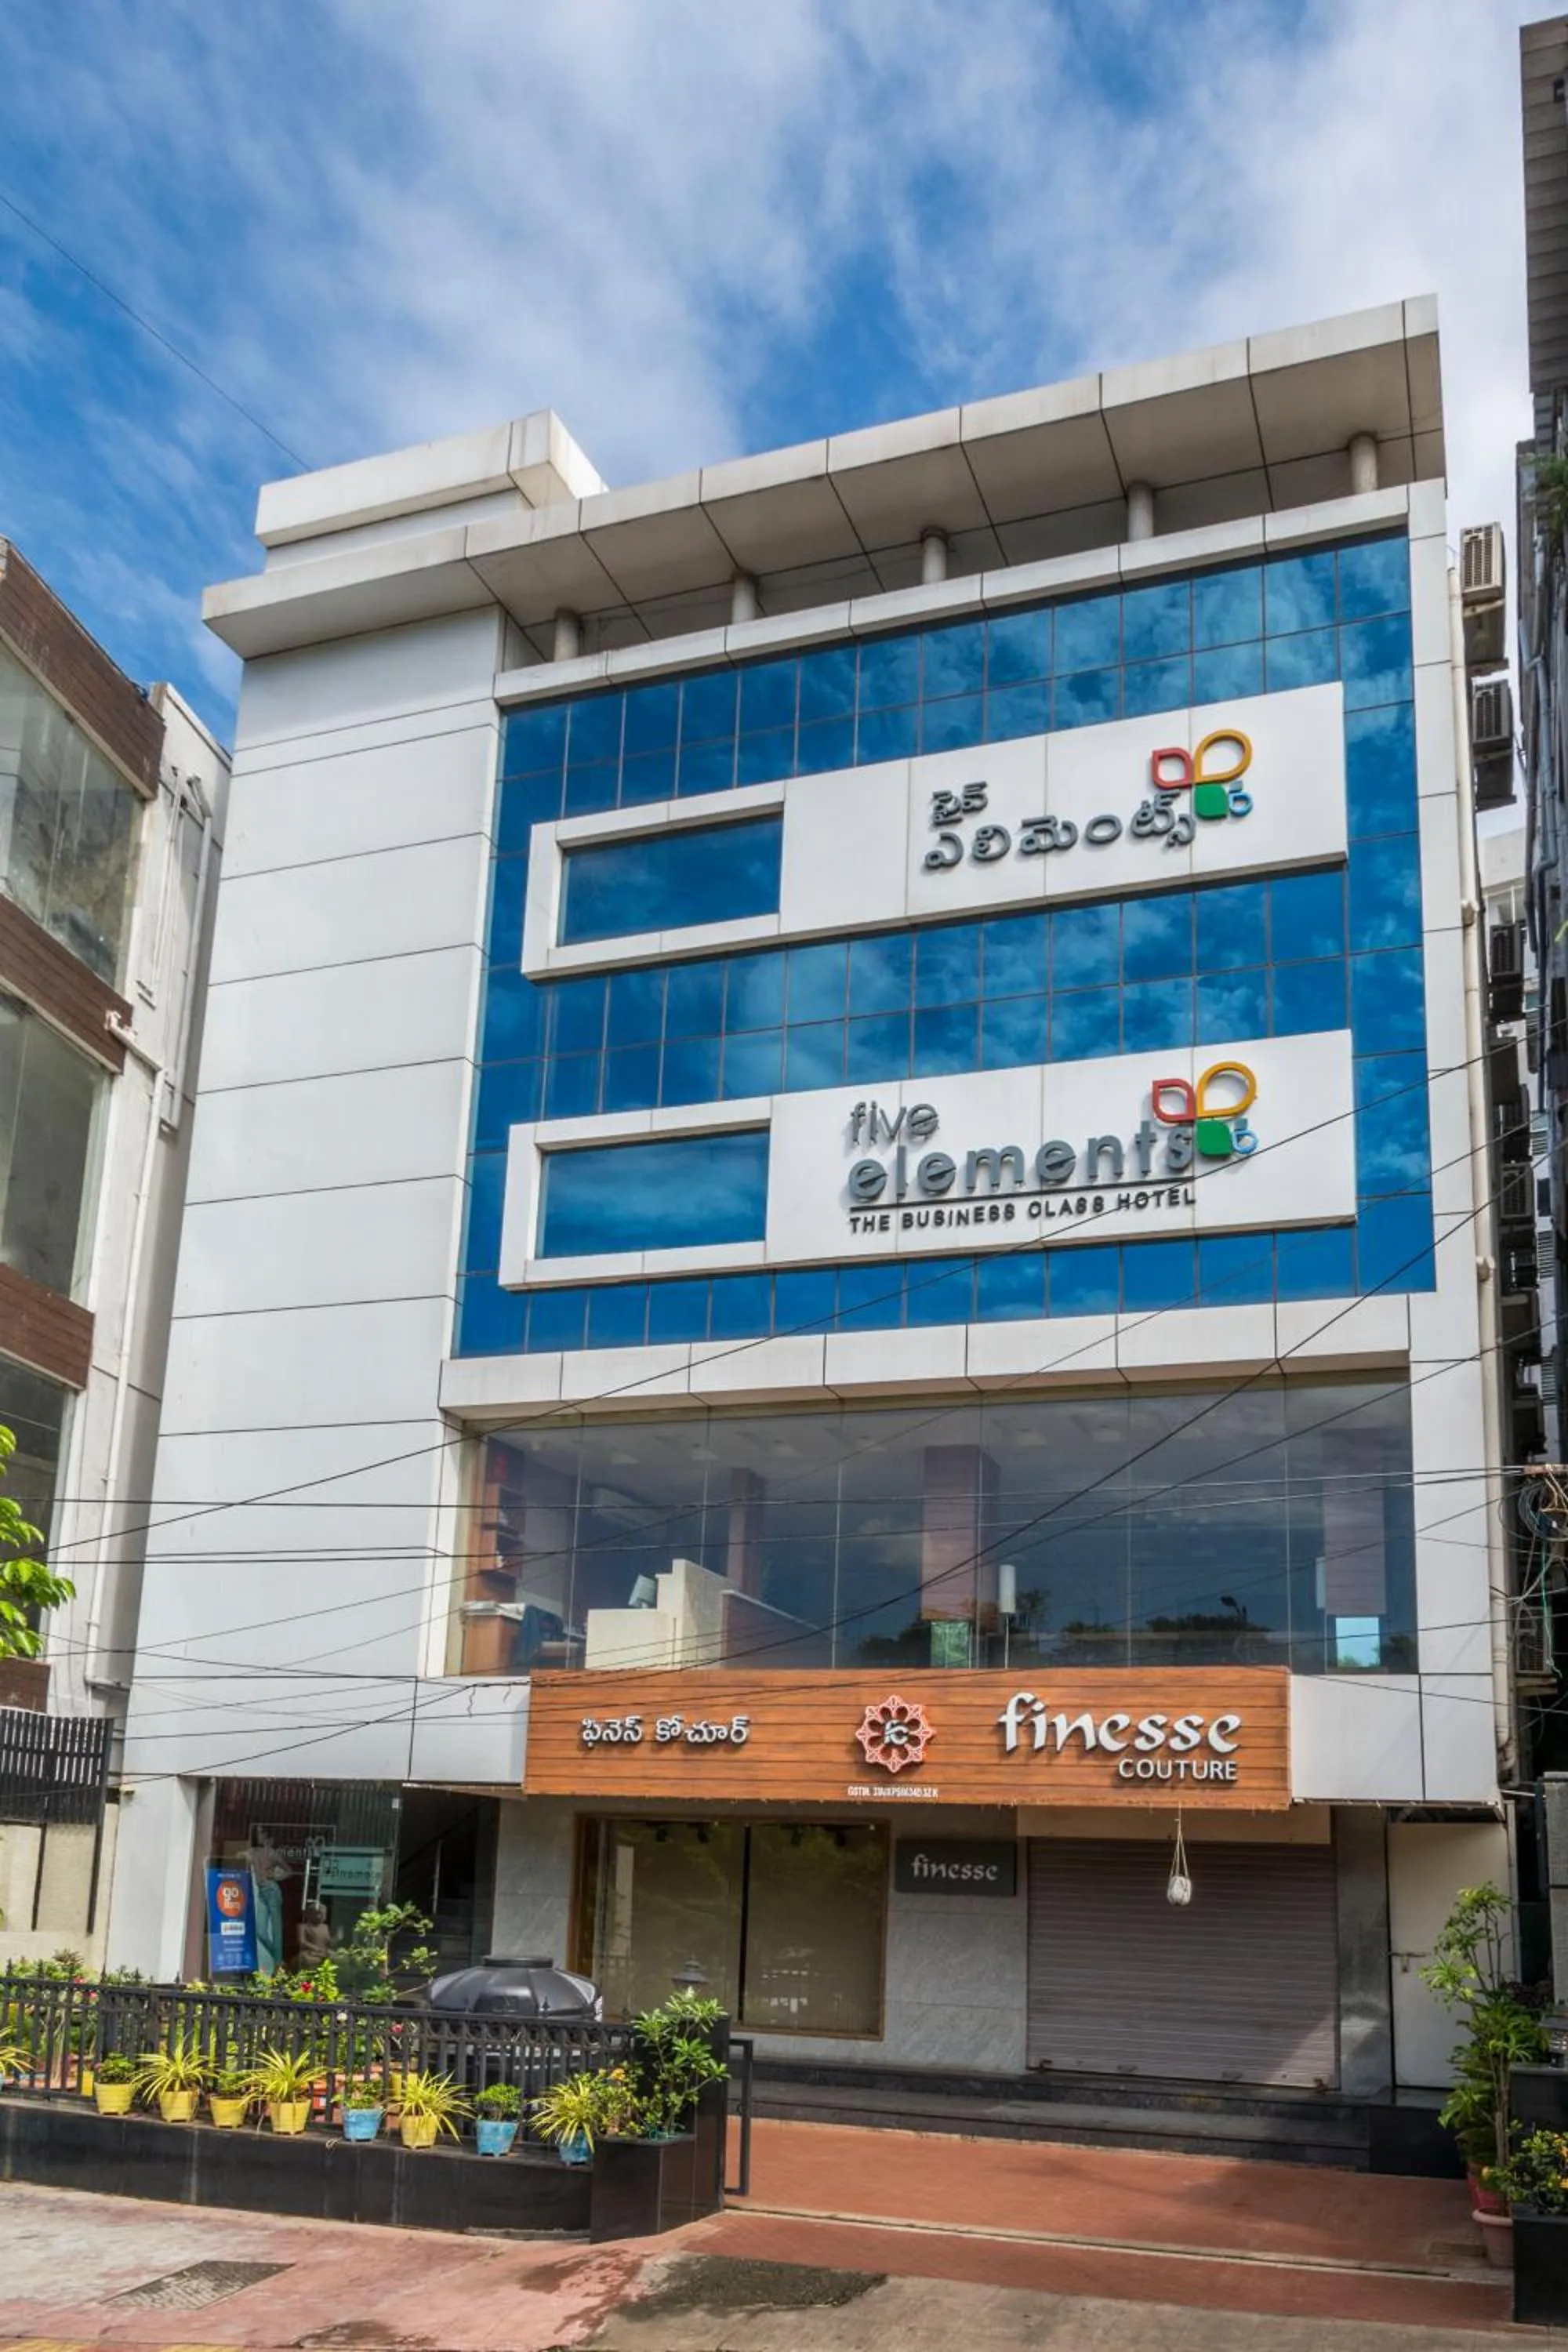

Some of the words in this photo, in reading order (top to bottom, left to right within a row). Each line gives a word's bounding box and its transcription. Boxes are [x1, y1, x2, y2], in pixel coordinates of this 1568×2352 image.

[924, 789, 1196, 869] ఎలిమెంట్స్
[850, 1100, 939, 1145] five
[848, 1120, 1193, 1200] elements
[849, 1214, 891, 1234] THE
[902, 1203, 1015, 1229] BUSINESS
[1028, 1195, 1105, 1218] CLASS
[1117, 1188, 1196, 1210] HOTEL
[997, 1692, 1243, 1754] finesse
[1118, 1758, 1238, 1782] COUTURE
[910, 1853, 999, 1881] finesse
[223, 1887, 239, 1901] go
